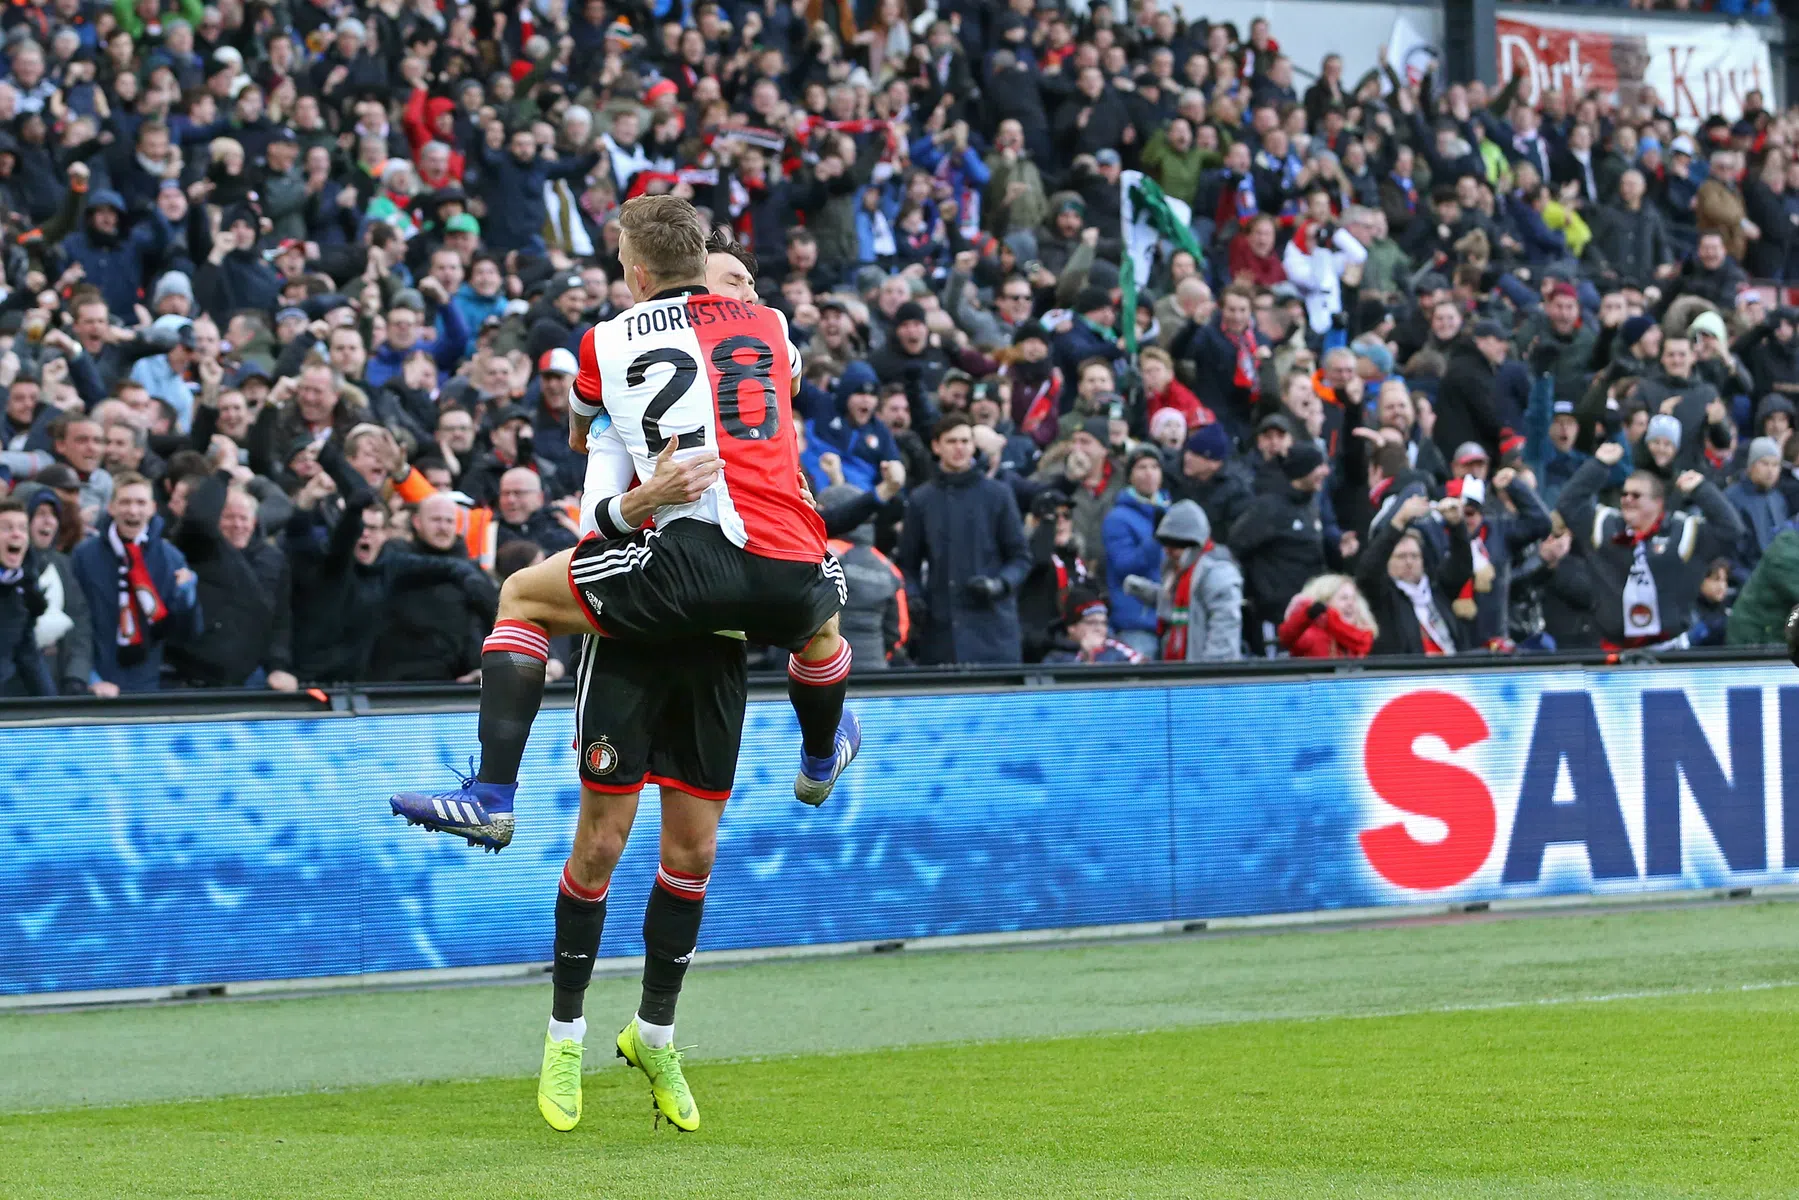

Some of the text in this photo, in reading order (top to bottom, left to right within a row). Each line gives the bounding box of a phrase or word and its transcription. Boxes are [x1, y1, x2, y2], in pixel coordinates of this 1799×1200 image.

[1498, 34, 1593, 107] Dirk
[624, 301, 758, 341] TOORNSTRA
[626, 335, 779, 458] 28
